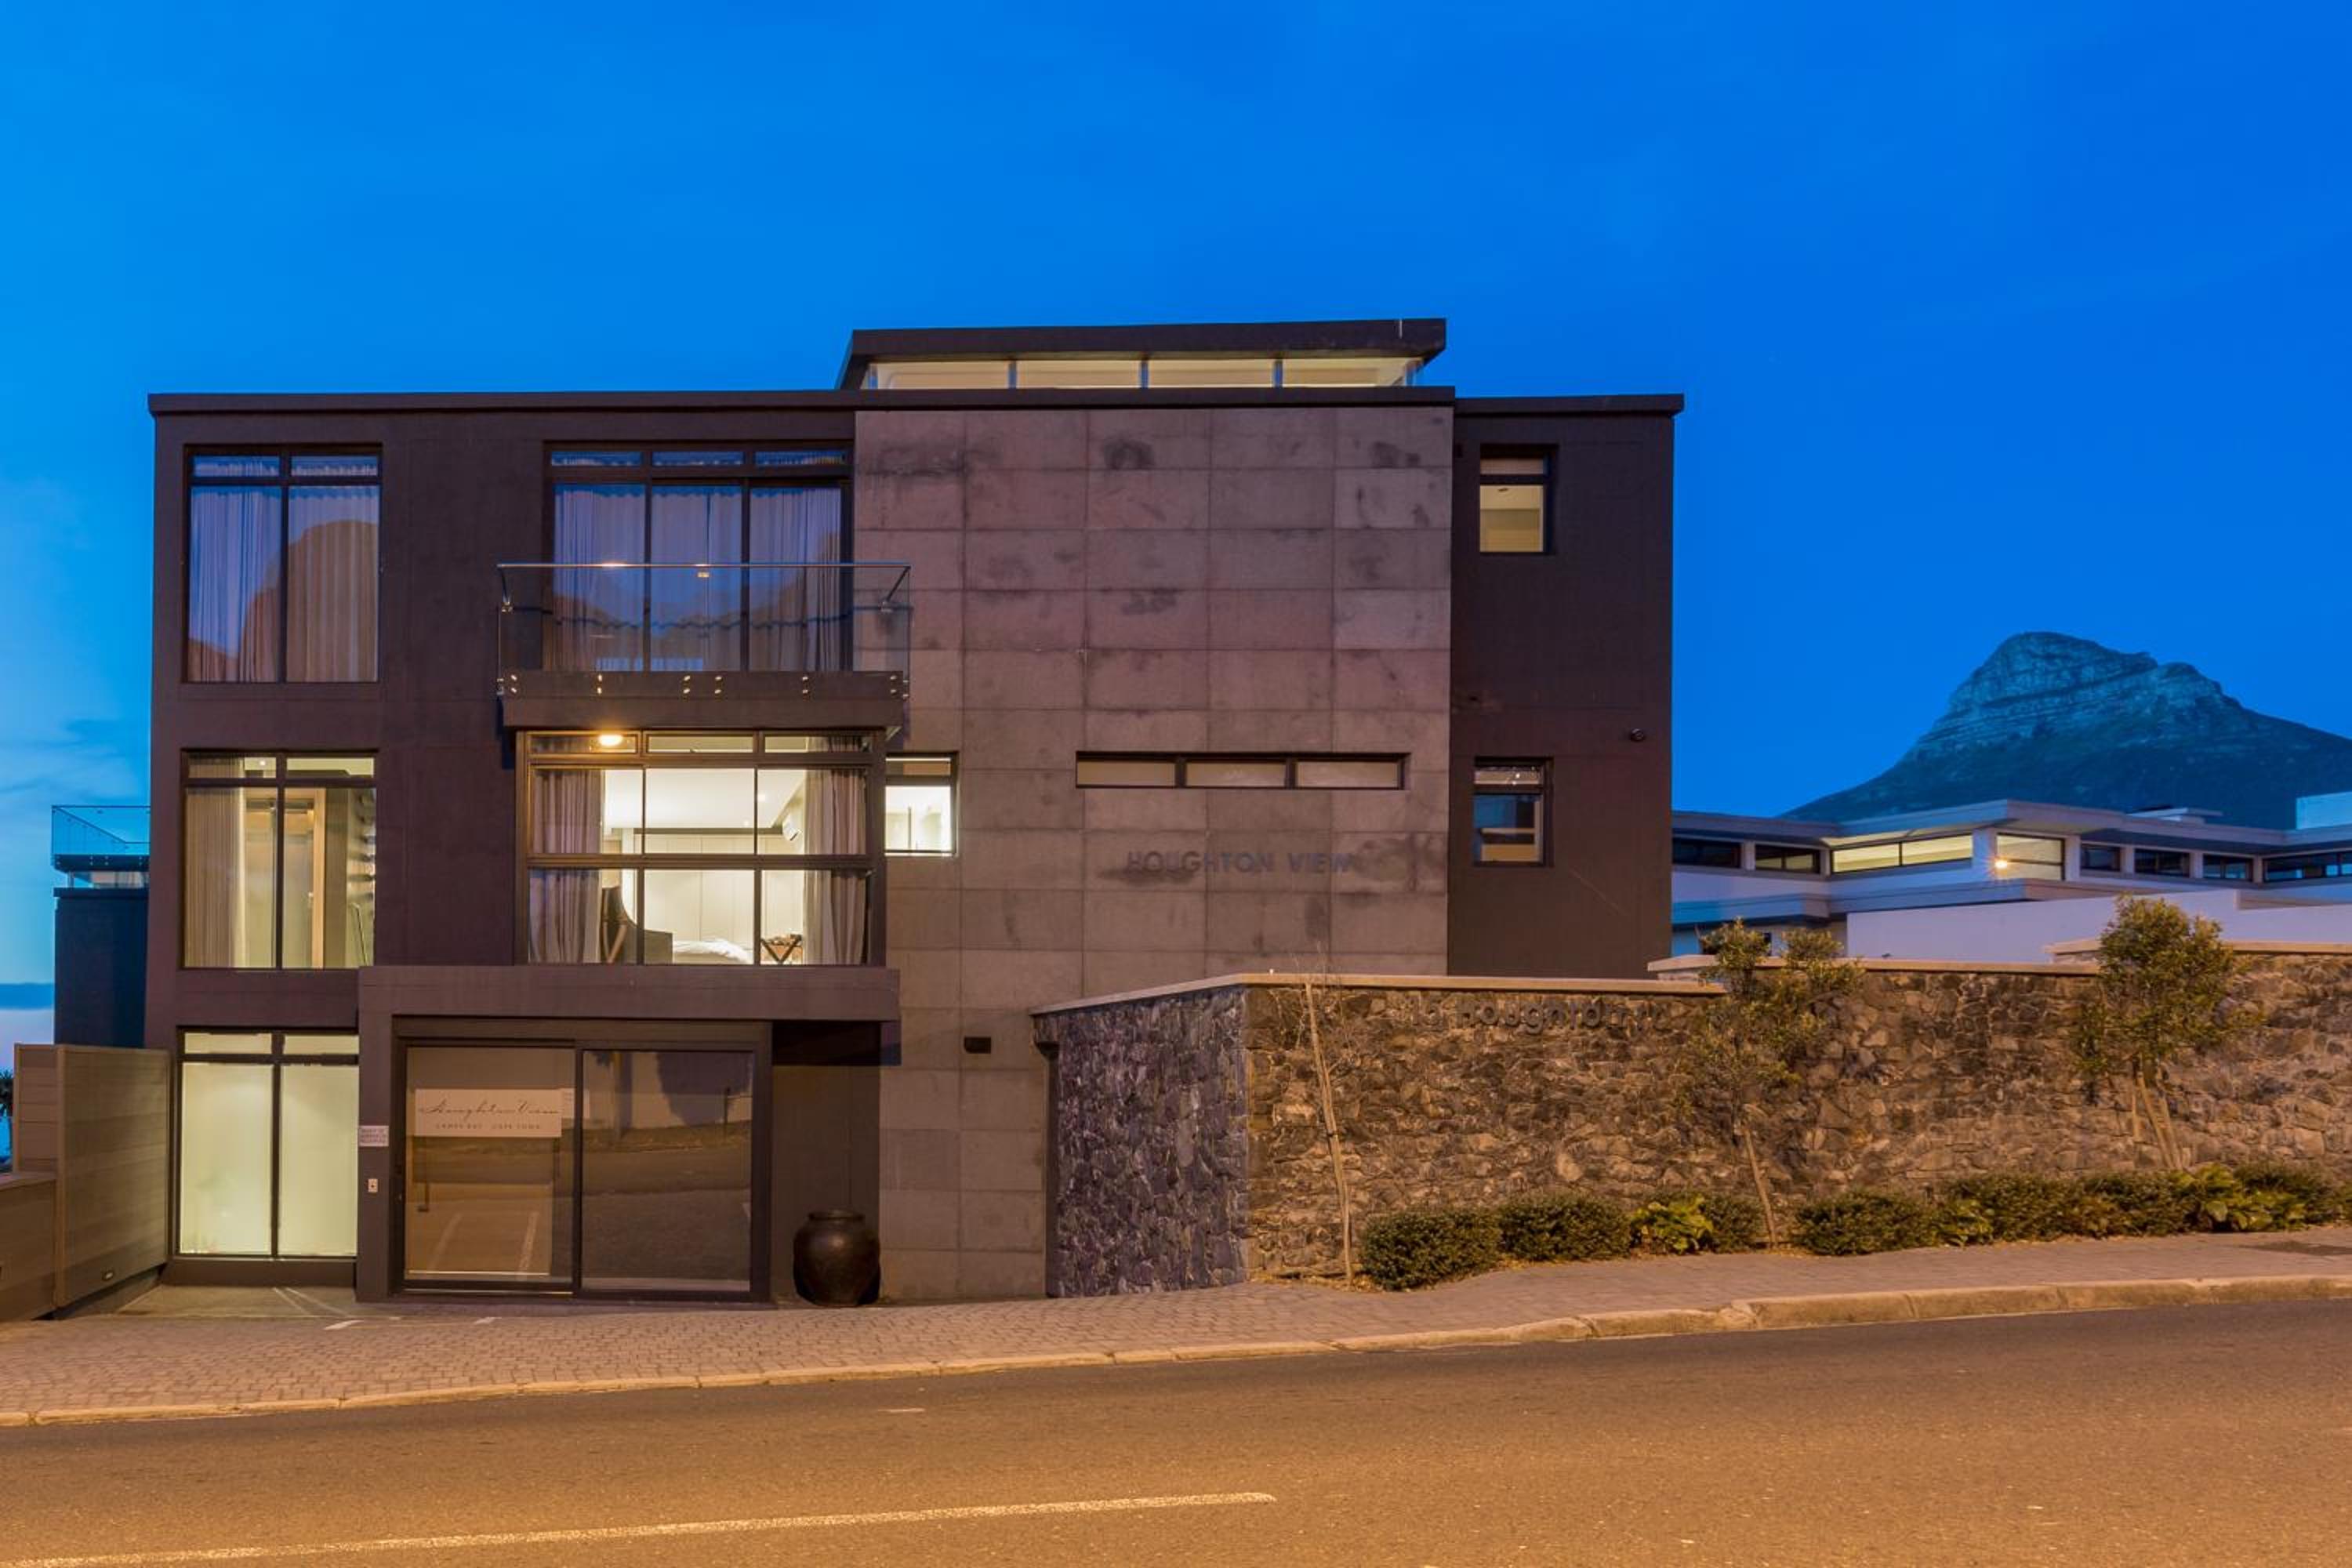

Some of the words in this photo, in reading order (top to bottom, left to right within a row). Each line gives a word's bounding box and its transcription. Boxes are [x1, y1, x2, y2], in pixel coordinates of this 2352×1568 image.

[1127, 851, 1275, 873] HOUGHTON
[1287, 851, 1355, 874] VIEW
[1456, 997, 1626, 1035] Houghton
